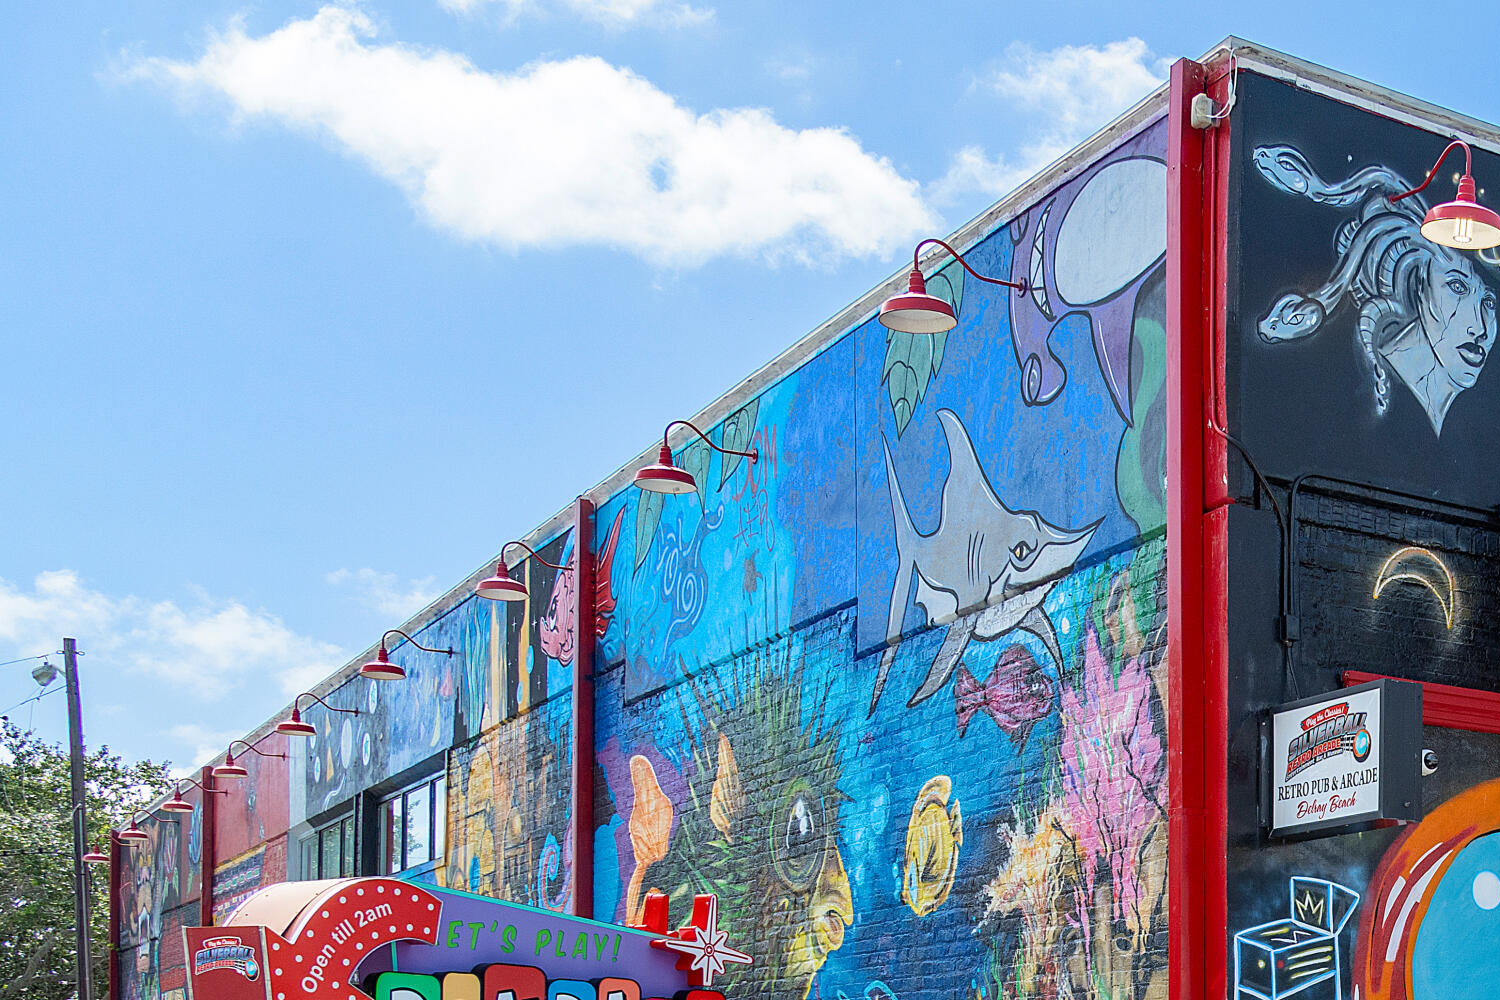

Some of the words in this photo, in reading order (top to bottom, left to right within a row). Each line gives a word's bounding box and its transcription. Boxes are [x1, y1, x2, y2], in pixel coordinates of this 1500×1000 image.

[1287, 750, 1311, 775] RETRO
[1312, 739, 1340, 758] ARCADE
[1289, 712, 1366, 762] SILVERBALL
[1278, 782, 1309, 801] RETRO
[1311, 778, 1330, 795] PUB
[1331, 775, 1339, 790] &
[1339, 767, 1378, 789] ARCADE
[1296, 799, 1328, 820] Delray
[1329, 791, 1356, 813] Beach
[301, 944, 334, 993] Open
[331, 918, 356, 944] till
[353, 902, 393, 928] 2am
[446, 919, 517, 955] ET'S
[536, 928, 622, 963] PLAY!
